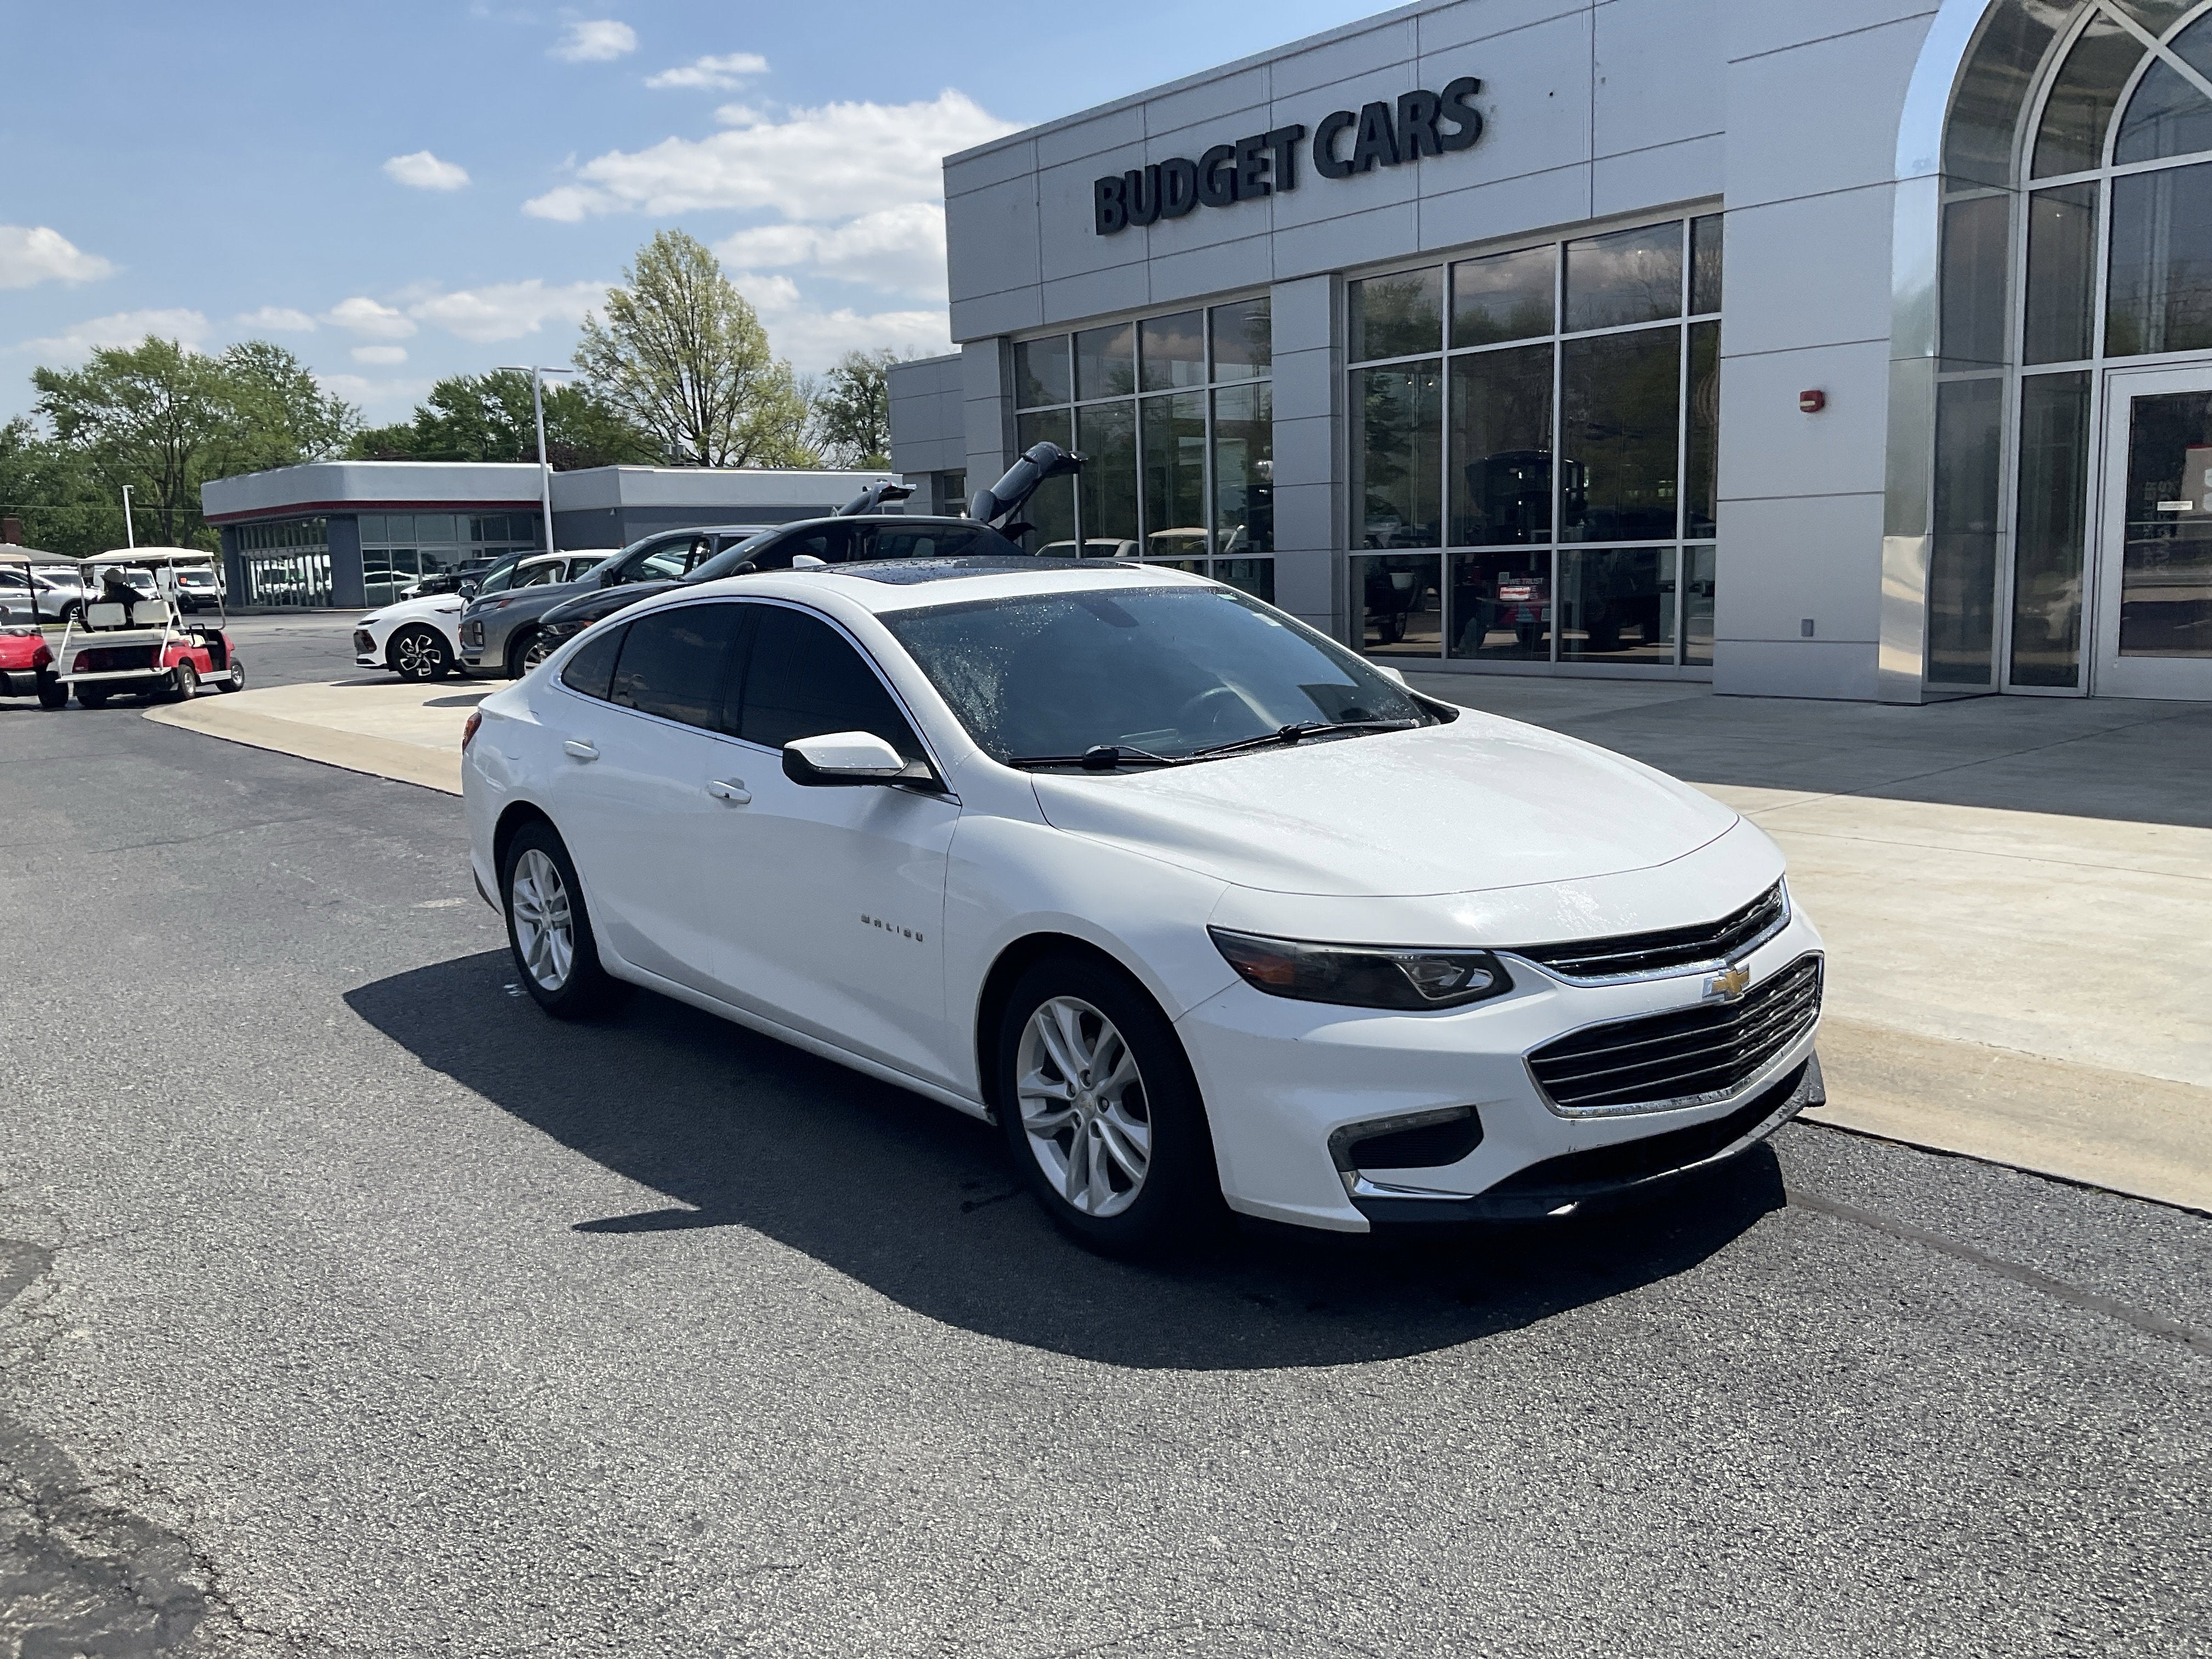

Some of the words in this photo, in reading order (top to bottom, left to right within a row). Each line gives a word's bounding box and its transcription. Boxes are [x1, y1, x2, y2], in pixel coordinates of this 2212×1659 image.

[1094, 124, 1305, 235] BUDGET
[1312, 76, 1482, 179] CARS
[860, 913, 923, 943] MALIBU
